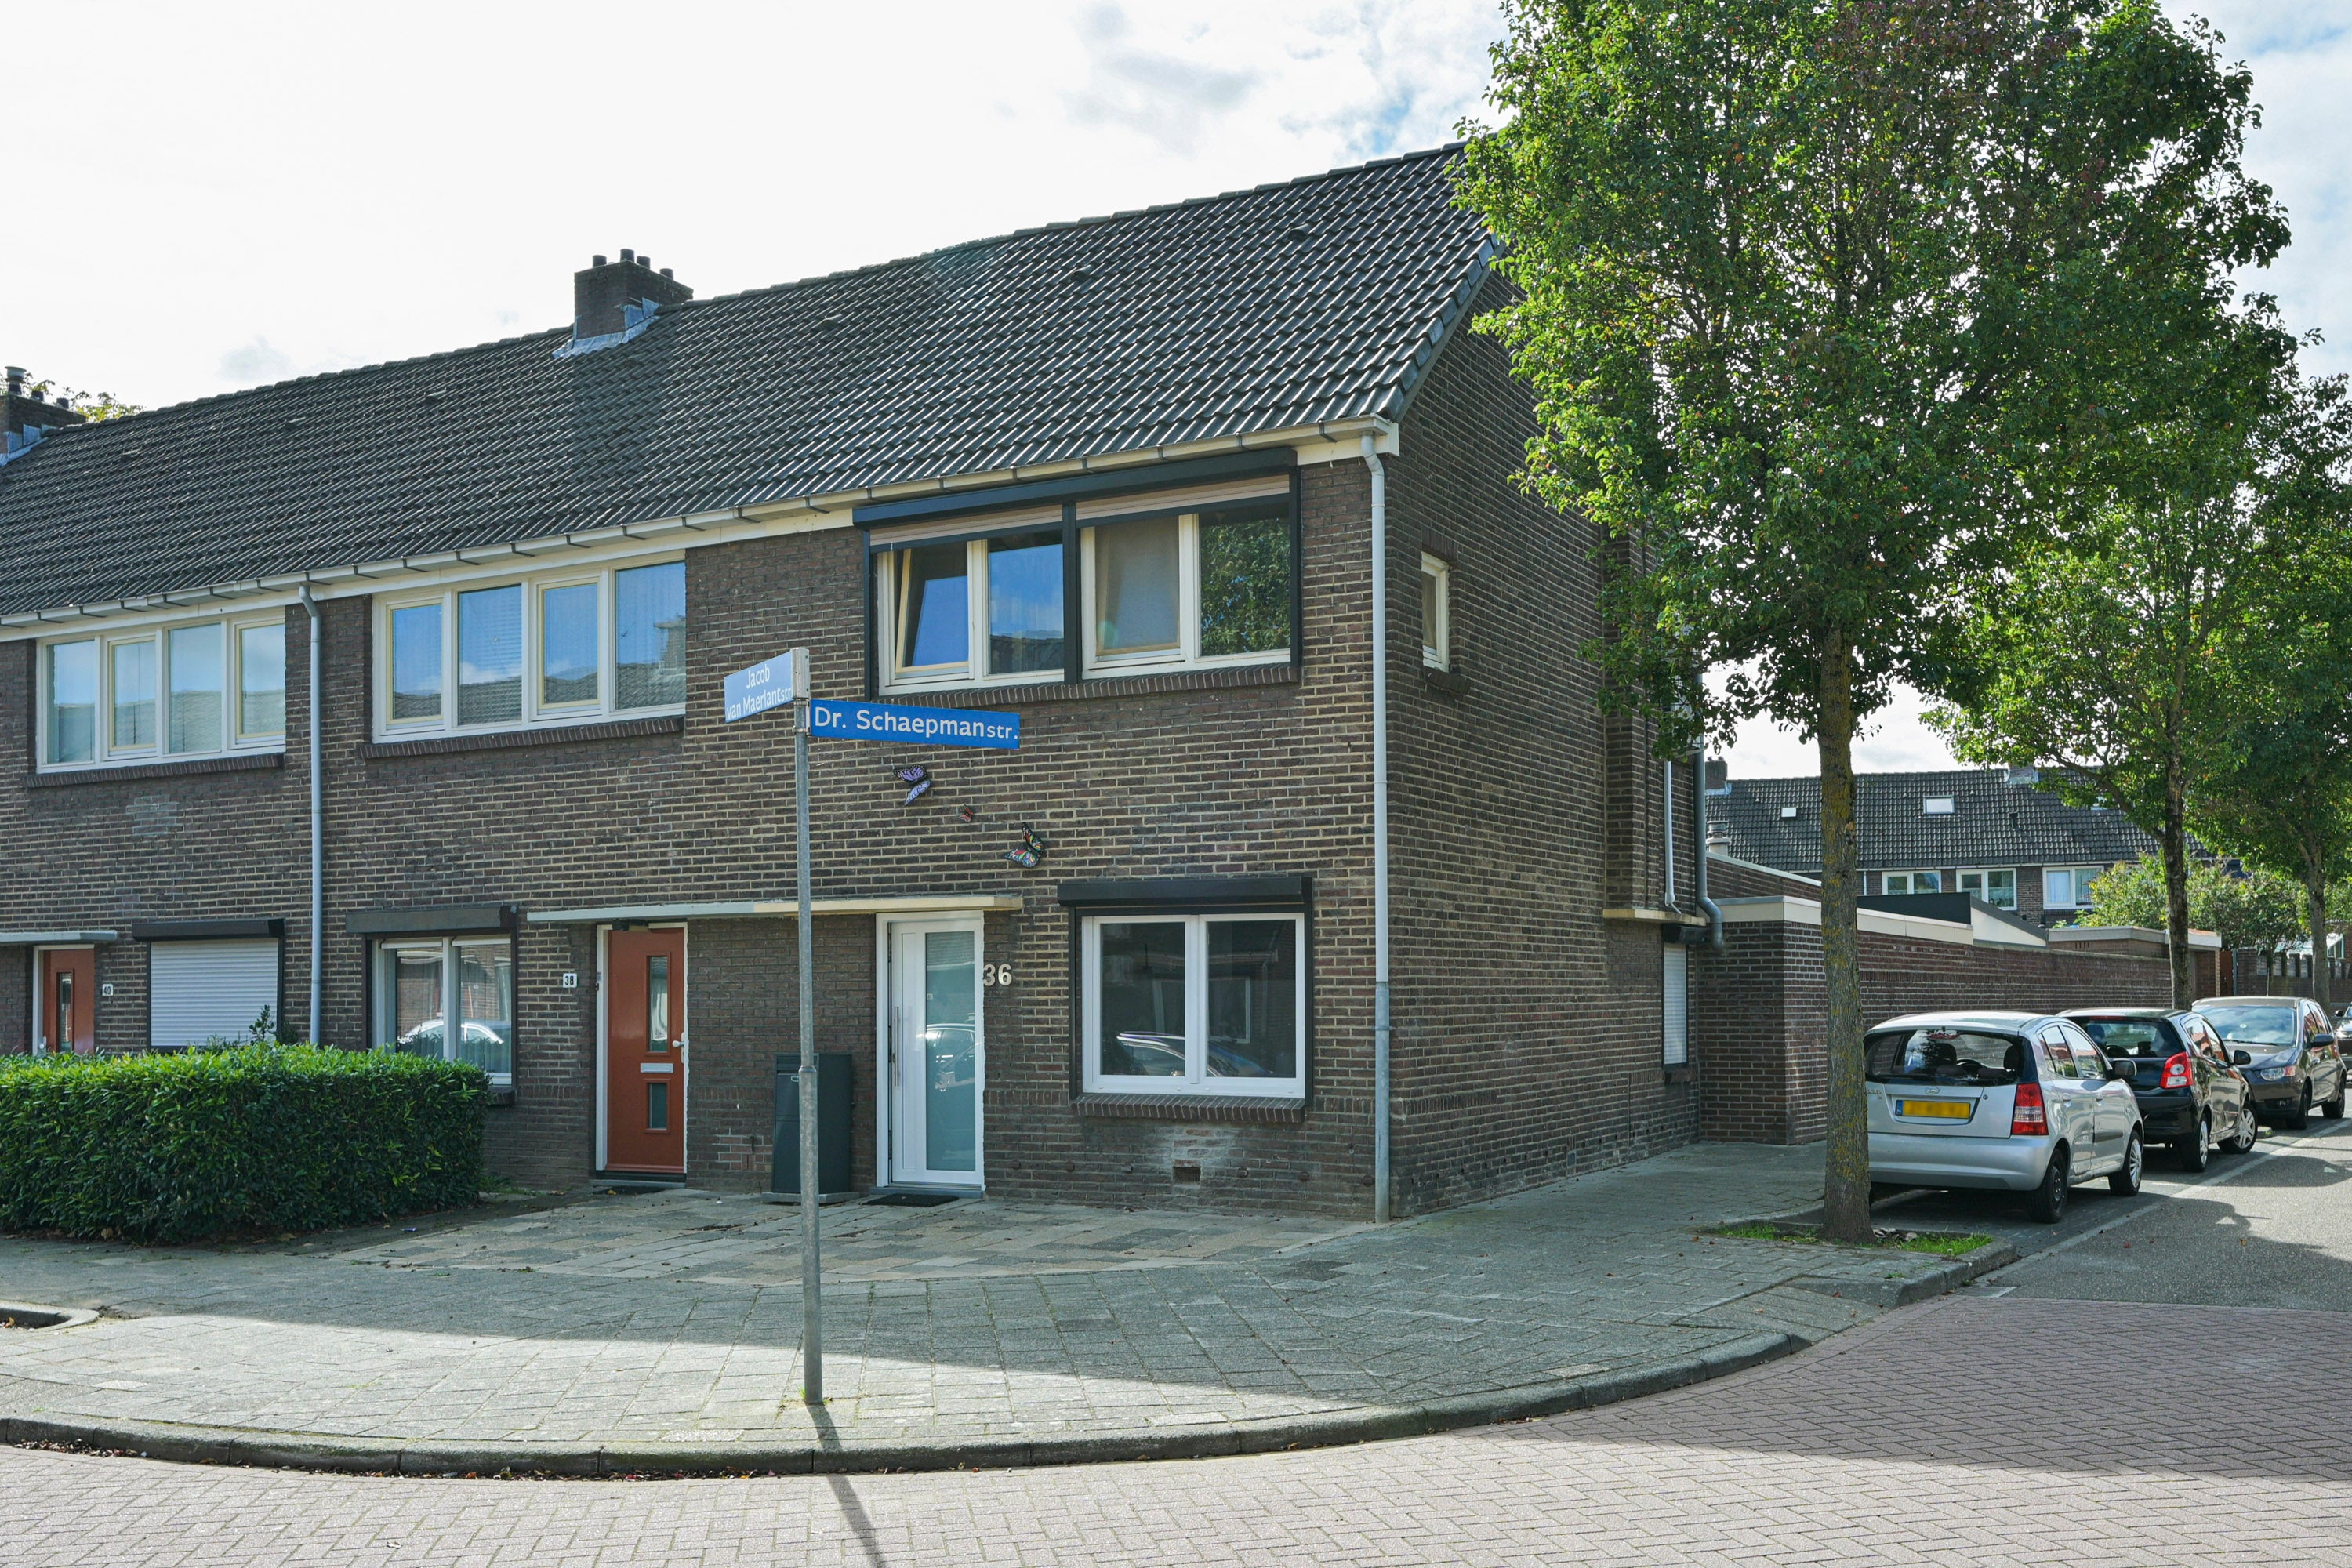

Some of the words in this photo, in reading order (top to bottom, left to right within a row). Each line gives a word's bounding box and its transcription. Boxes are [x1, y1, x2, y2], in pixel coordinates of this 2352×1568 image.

[746, 663, 771, 689] Jacob
[726, 702, 742, 720] van
[815, 706, 846, 729] Dr.
[564, 975, 574, 985] 38
[983, 964, 1012, 986] 36
[103, 985, 111, 995] 40
